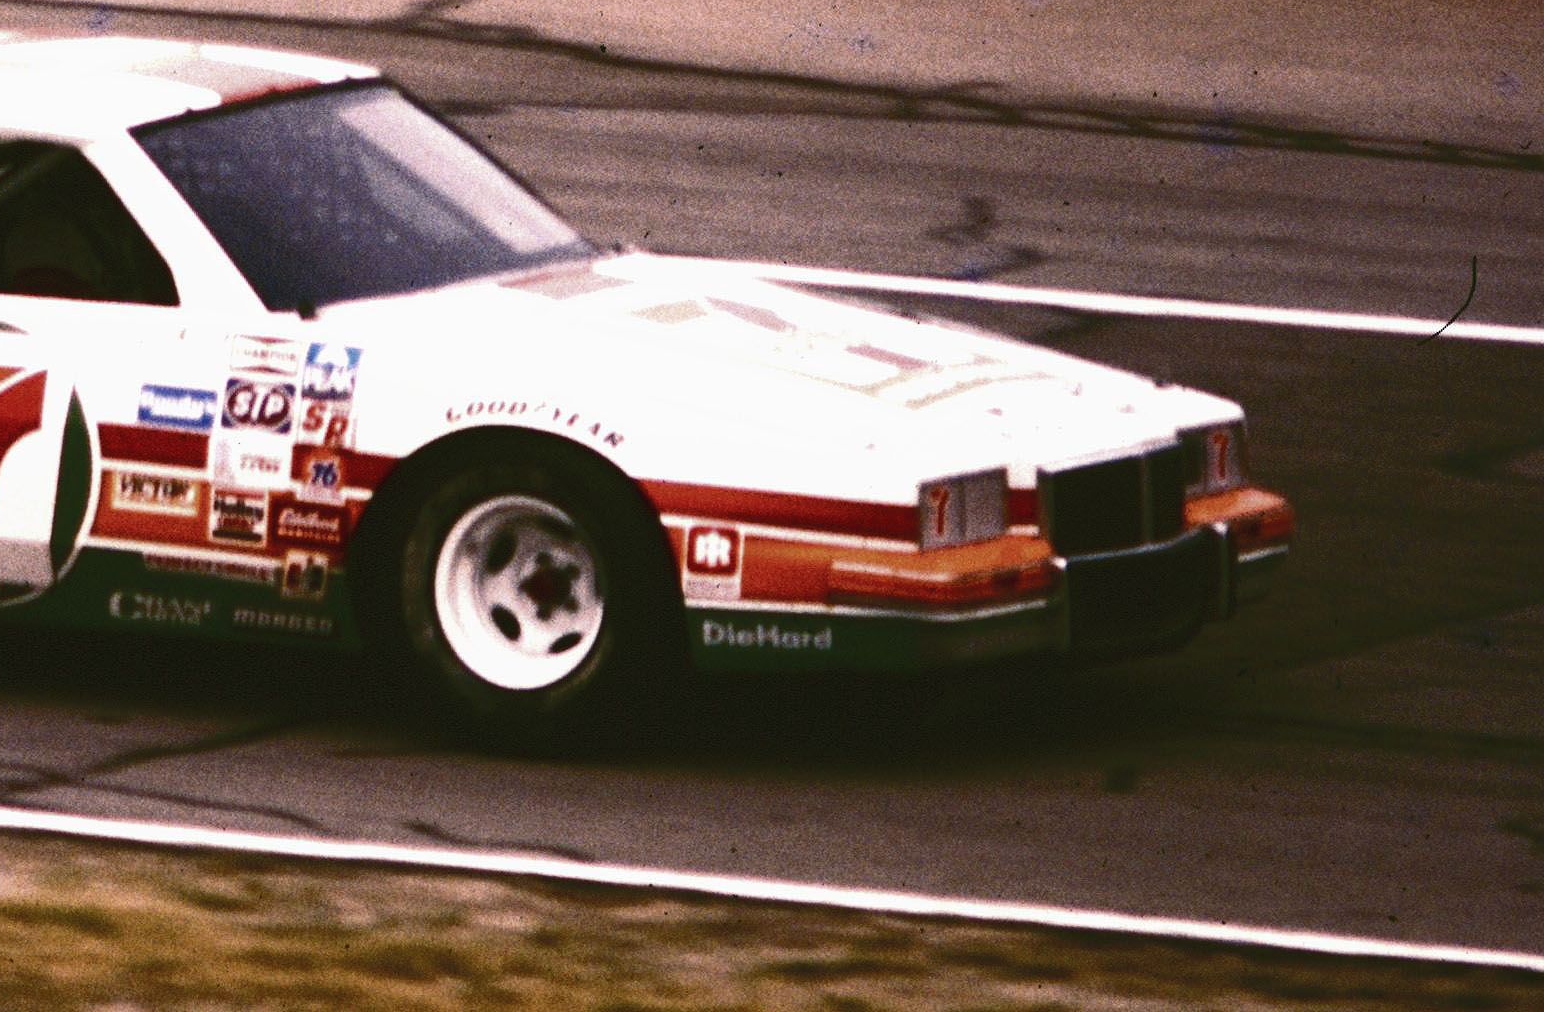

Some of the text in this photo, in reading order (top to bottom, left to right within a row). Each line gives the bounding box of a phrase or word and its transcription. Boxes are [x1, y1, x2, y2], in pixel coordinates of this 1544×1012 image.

[232, 384, 285, 421] STP
[311, 460, 338, 486] 76
[1211, 433, 1229, 479] 7
[930, 488, 948, 536] 7
[702, 620, 833, 650] DieHard
